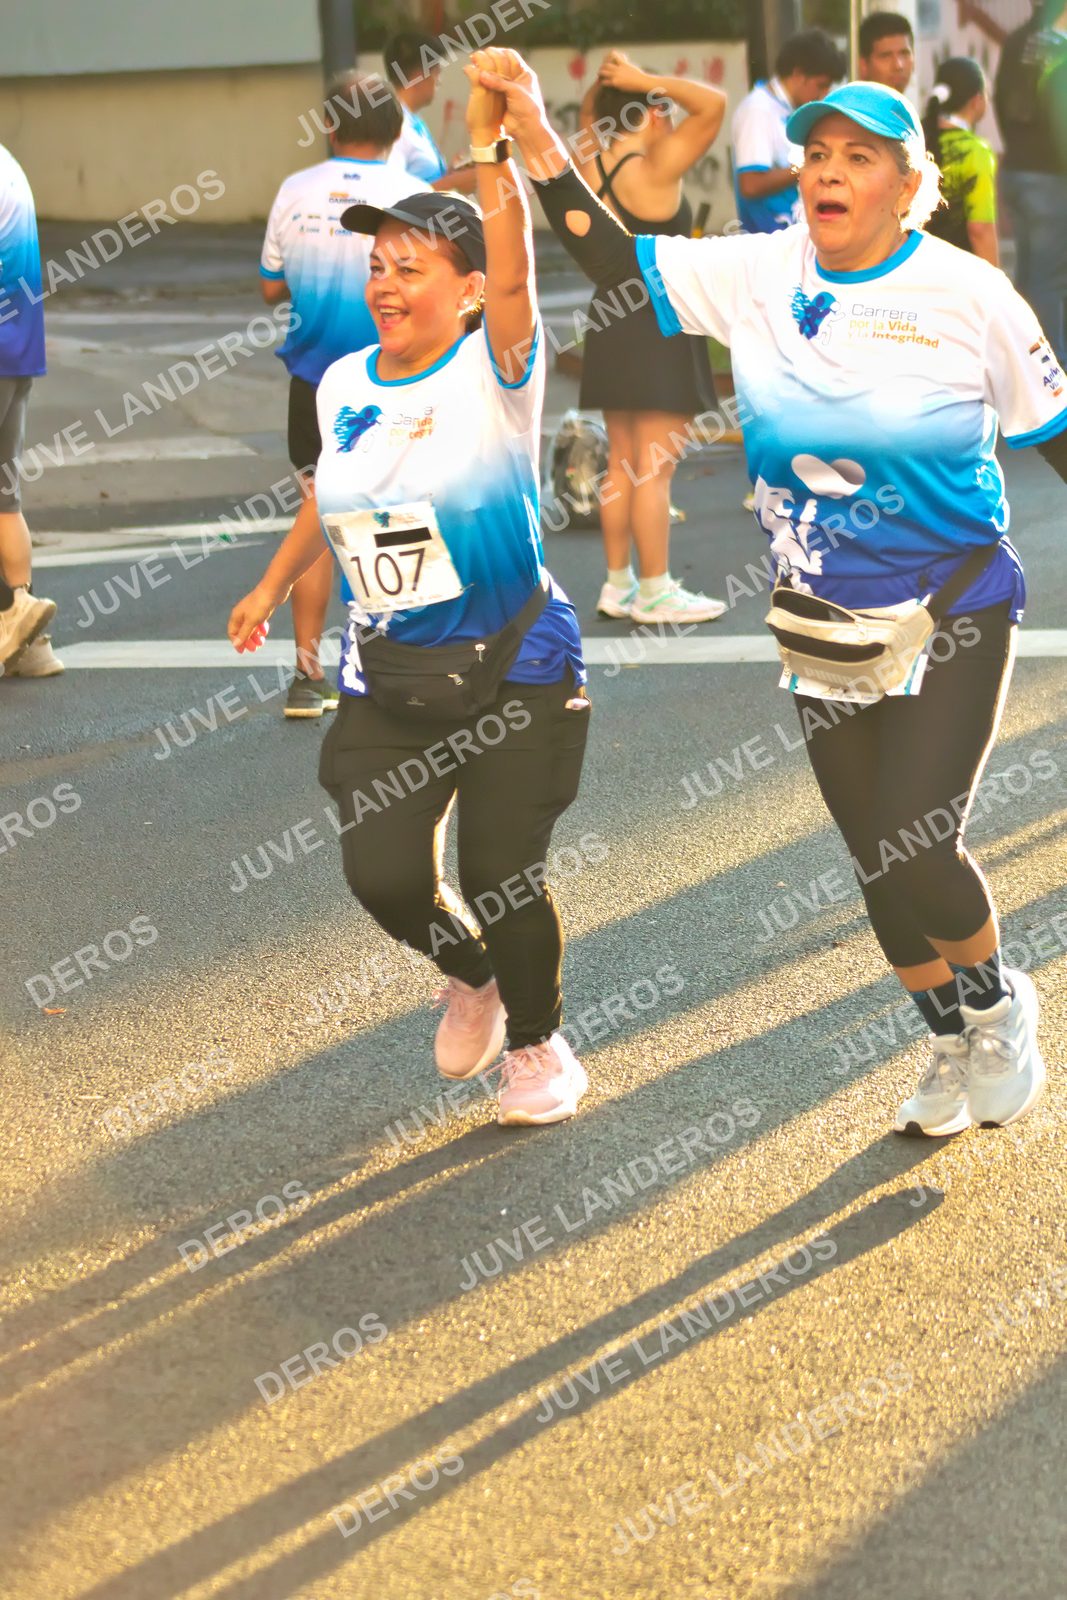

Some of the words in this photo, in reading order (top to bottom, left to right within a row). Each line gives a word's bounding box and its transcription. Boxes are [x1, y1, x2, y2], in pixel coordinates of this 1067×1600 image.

[851, 303, 918, 322] Carrera
[888, 321, 917, 333] Vida
[872, 331, 940, 349] Integridad
[350, 547, 426, 598] 107
